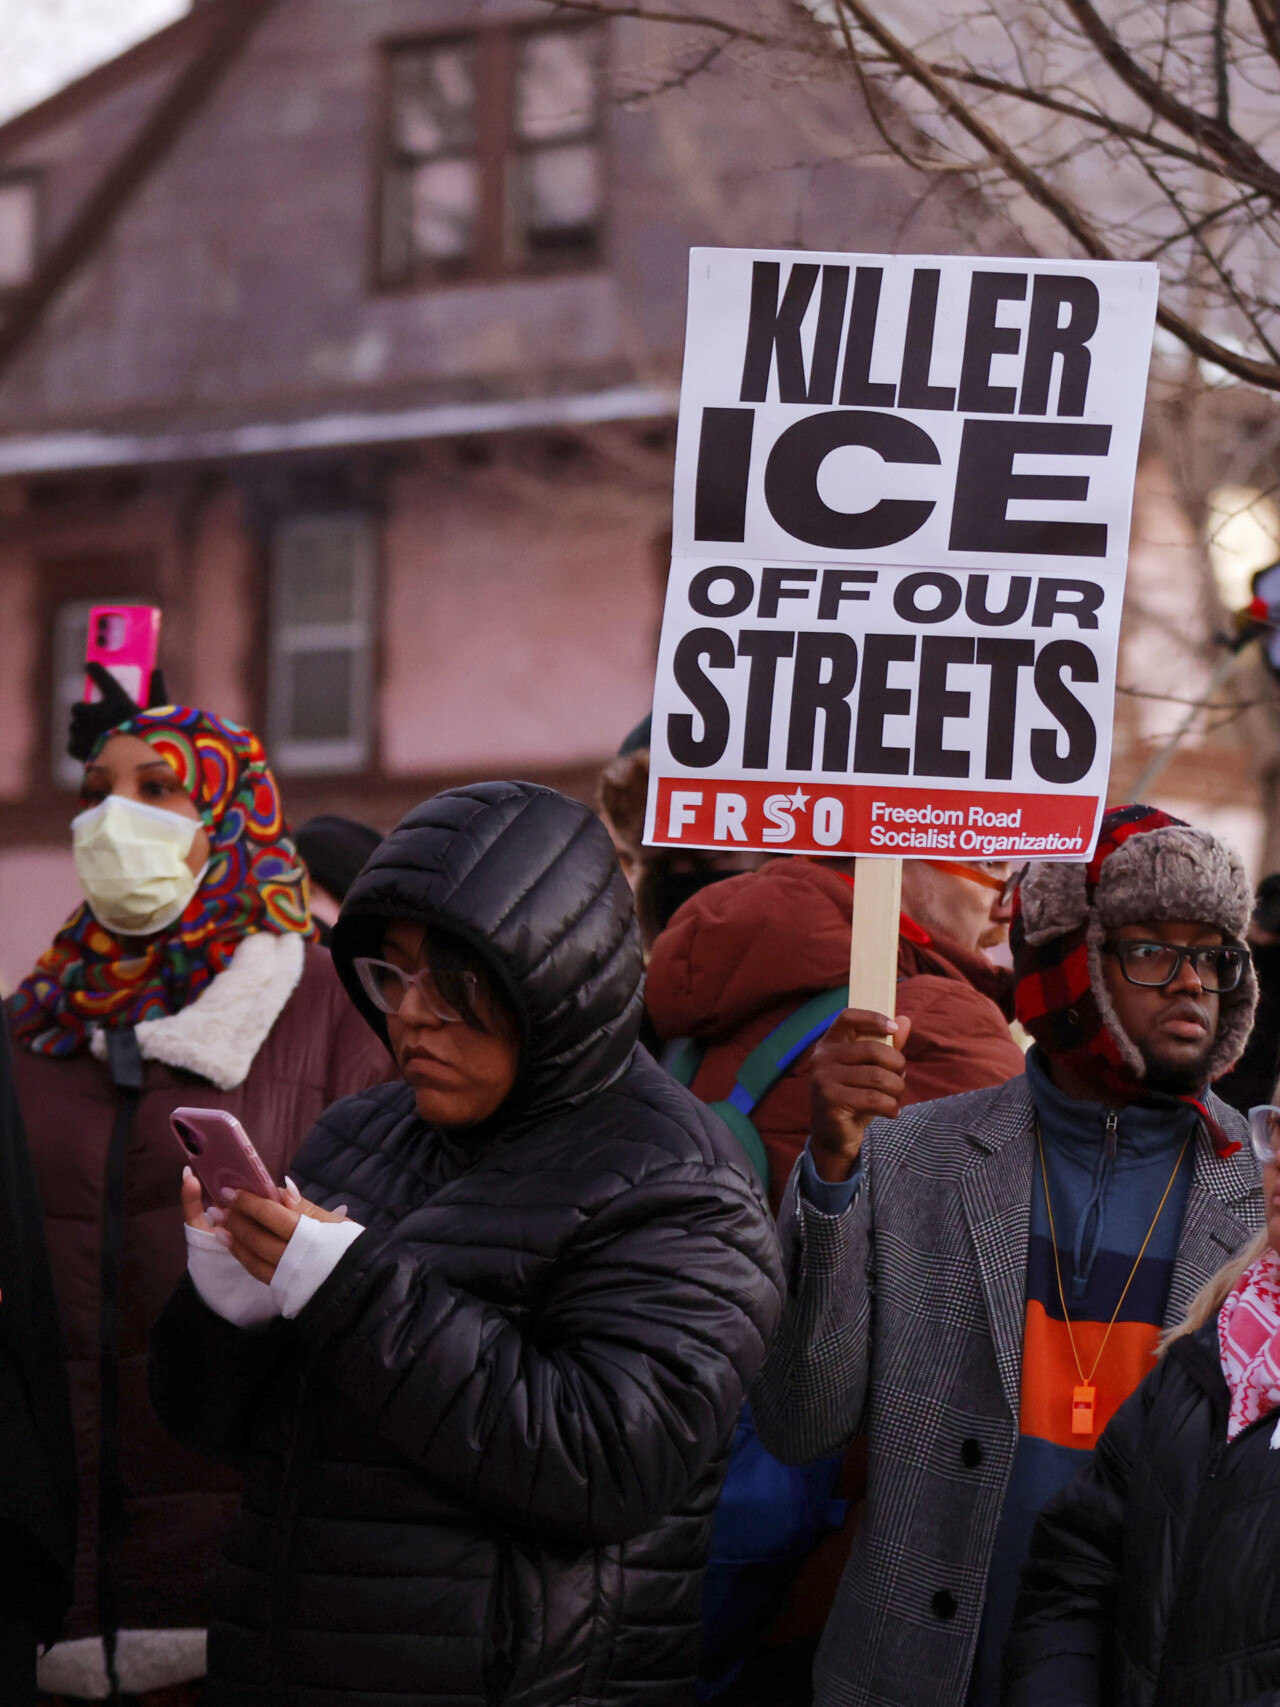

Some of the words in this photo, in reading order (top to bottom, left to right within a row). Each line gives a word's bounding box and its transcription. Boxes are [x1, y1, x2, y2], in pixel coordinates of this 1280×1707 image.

[739, 260, 1100, 417] KILLER
[694, 407, 1113, 558] ICE
[687, 565, 878, 621] OFF
[892, 571, 1106, 630] OUR
[666, 627, 1100, 784] STREETS
[869, 825, 956, 849] Socialist
[959, 829, 1083, 855] Organization
[871, 801, 964, 826] Freedom
[967, 806, 1022, 828] Road
